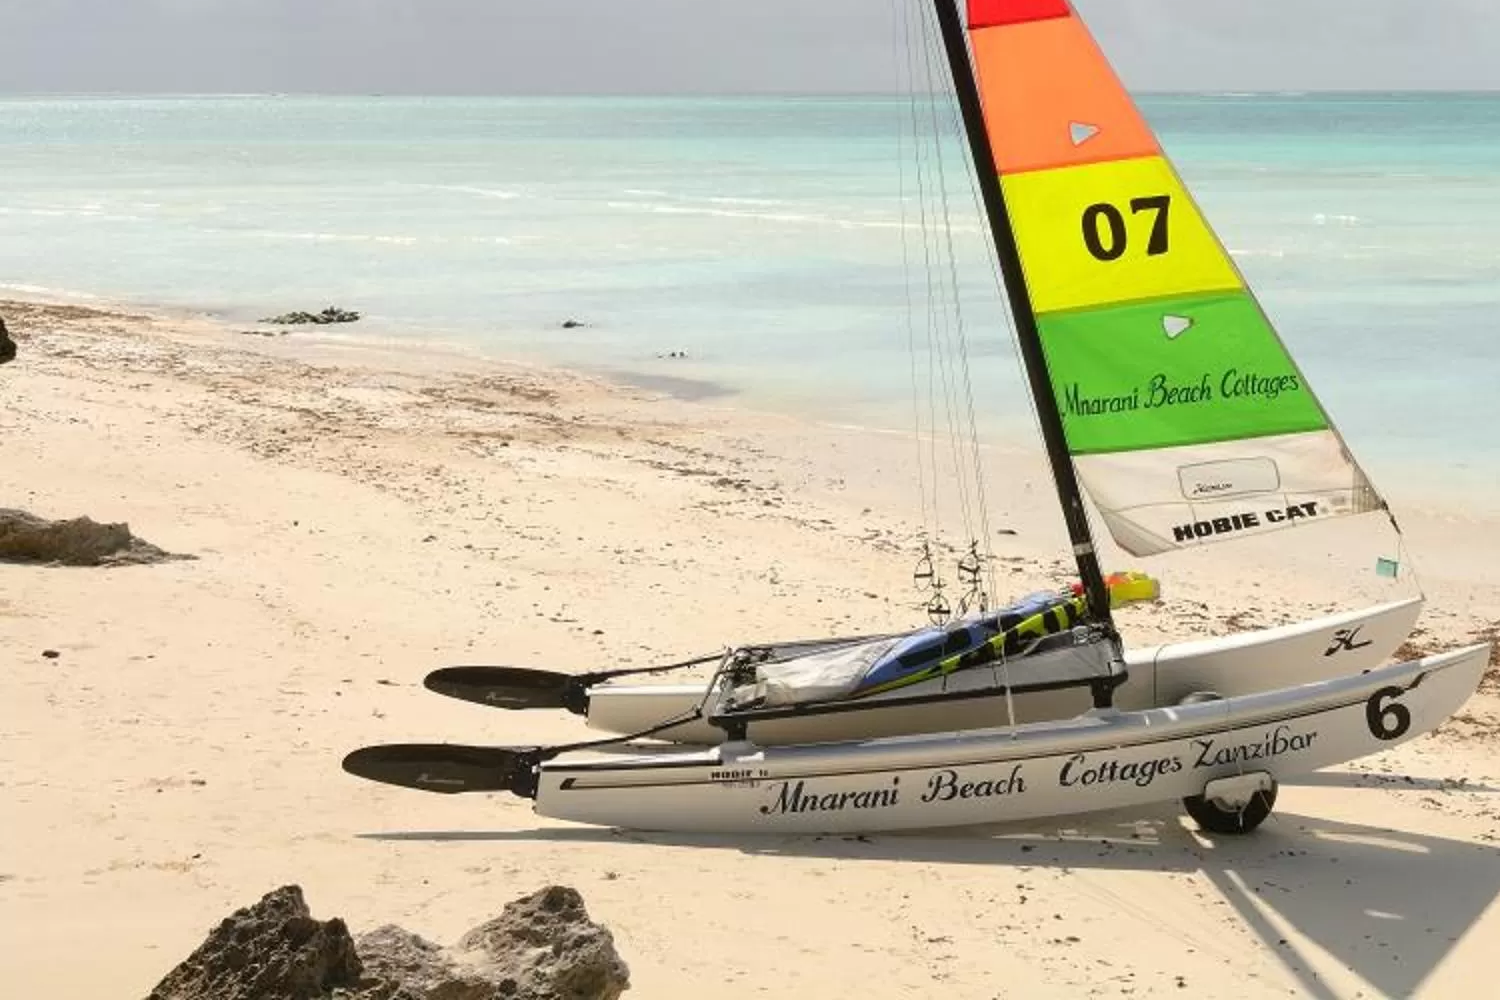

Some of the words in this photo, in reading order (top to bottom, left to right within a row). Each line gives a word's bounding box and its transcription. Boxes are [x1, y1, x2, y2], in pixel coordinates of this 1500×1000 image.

[1081, 195, 1171, 261] 07
[1062, 383, 1139, 416] Mnarani
[1144, 373, 1212, 408] Beach
[1220, 368, 1299, 399] Cottages
[1172, 511, 1260, 542] HOBIE
[1265, 501, 1318, 523] CAT
[1366, 686, 1411, 740] 6
[760, 776, 900, 815] Mnarani
[921, 764, 1027, 803] Beach
[1058, 754, 1183, 787] Cottages
[1192, 725, 1318, 769] Zanzibar
